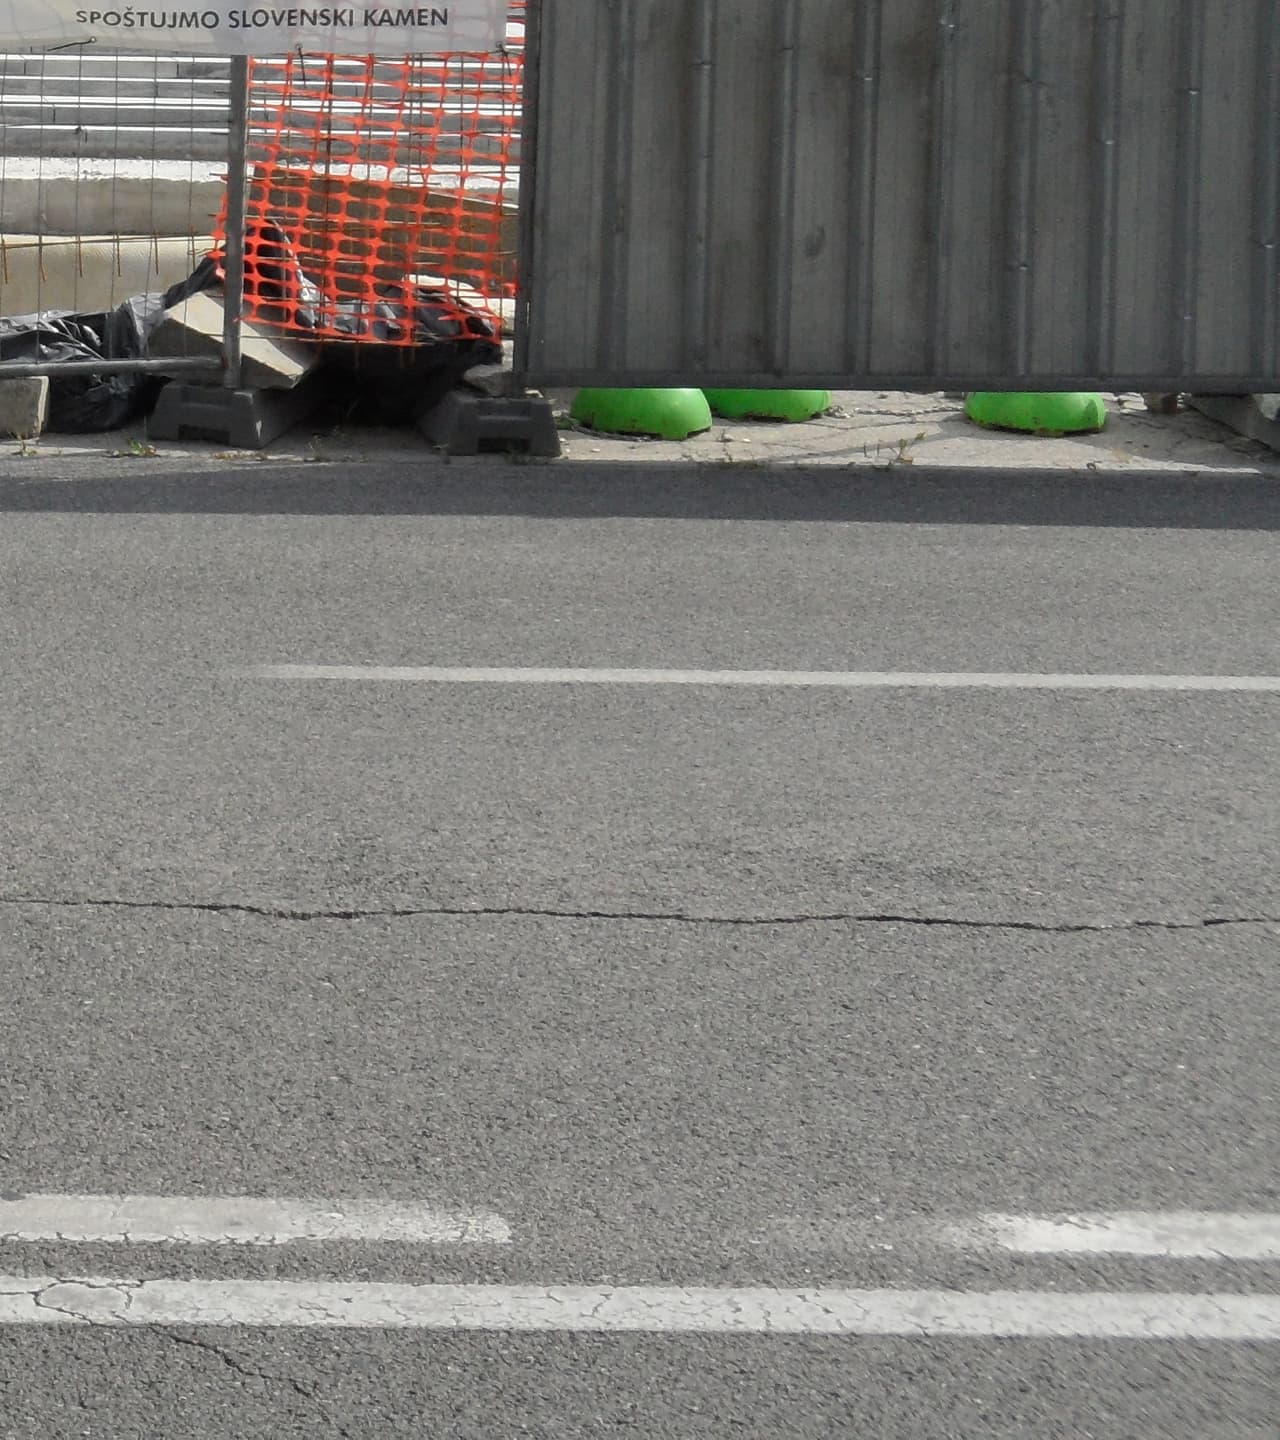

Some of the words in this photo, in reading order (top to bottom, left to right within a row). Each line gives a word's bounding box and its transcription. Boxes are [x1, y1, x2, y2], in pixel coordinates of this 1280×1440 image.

[75, 6, 220, 29] SPOŠTUJMO
[228, 9, 354, 28] SLOVENSKI
[363, 7, 449, 27] KAMEN
